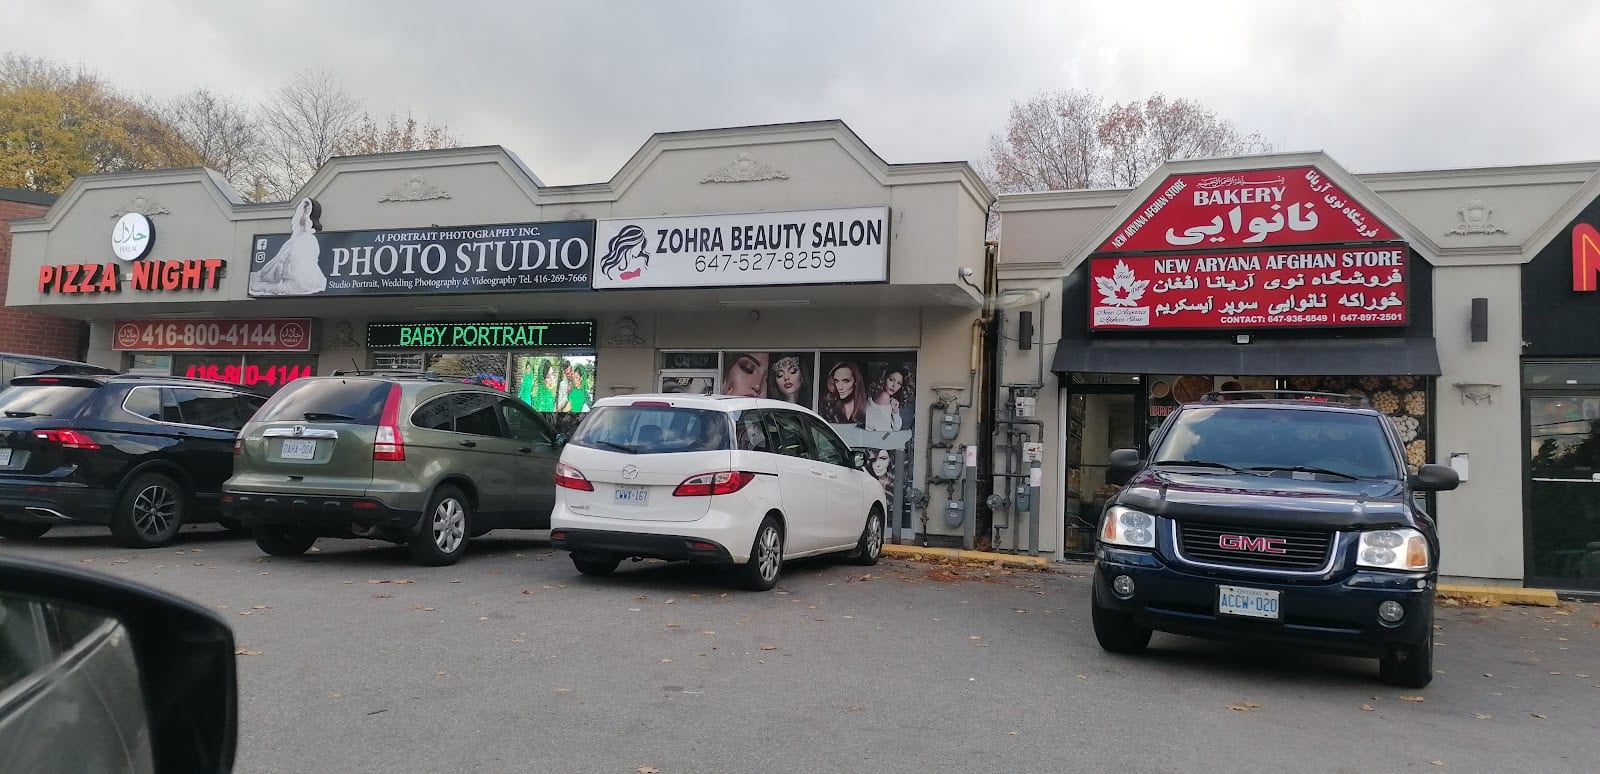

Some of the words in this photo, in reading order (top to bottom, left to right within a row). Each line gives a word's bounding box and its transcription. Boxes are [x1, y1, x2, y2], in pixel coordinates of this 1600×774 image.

[1194, 186, 1286, 206] BAKERY
[1111, 233, 1128, 249] NEW
[1124, 215, 1149, 238] ARYANA
[1144, 195, 1169, 220] AFGHAN
[1165, 178, 1187, 200] STORE
[114, 222, 147, 243] حلال
[1165, 202, 1319, 246] نانوایی
[374, 234, 385, 242] AJ
[387, 231, 438, 241] PORTRAIT
[439, 228, 517, 240] PHOTOGRAPHY
[518, 227, 541, 236] INC.
[656, 227, 724, 254] ZOHRA
[731, 223, 807, 251] BEAUTY
[811, 219, 882, 248] SALON
[329, 243, 448, 277] PHOTO
[455, 237, 589, 273] STUDIO
[695, 250, 836, 273] 647-527-8259
[1154, 258, 1191, 274] NEW
[1195, 255, 1261, 273] ARYANA
[1265, 253, 1336, 270] AFGHAN
[1341, 250, 1402, 267] STORE
[38, 262, 118, 294] PIZZA
[131, 259, 223, 290] NIGHT
[329, 280, 351, 289] Studio
[352, 279, 380, 289] Portrait,
[381, 278, 413, 289] Wedding
[414, 276, 462, 288] Photography
[462, 277, 470, 285] &
[471, 275, 518, 287] Videography
[533, 273, 588, 284] 416-269-7666
[1152, 275, 1199, 293] افغان
[1311, 268, 1402, 288] فروشگاه
[1218, 301, 1258, 315] سوپر
[1220, 316, 1266, 324] CONTACT:
[1267, 314, 1328, 323] 647-936-6549
[1340, 313, 1402, 322] 647-897-2501
[141, 324, 276, 346] 416-800-4144
[399, 327, 447, 346] BABY
[452, 326, 549, 346] PORTRAIT
[1219, 534, 1286, 554] GMC
